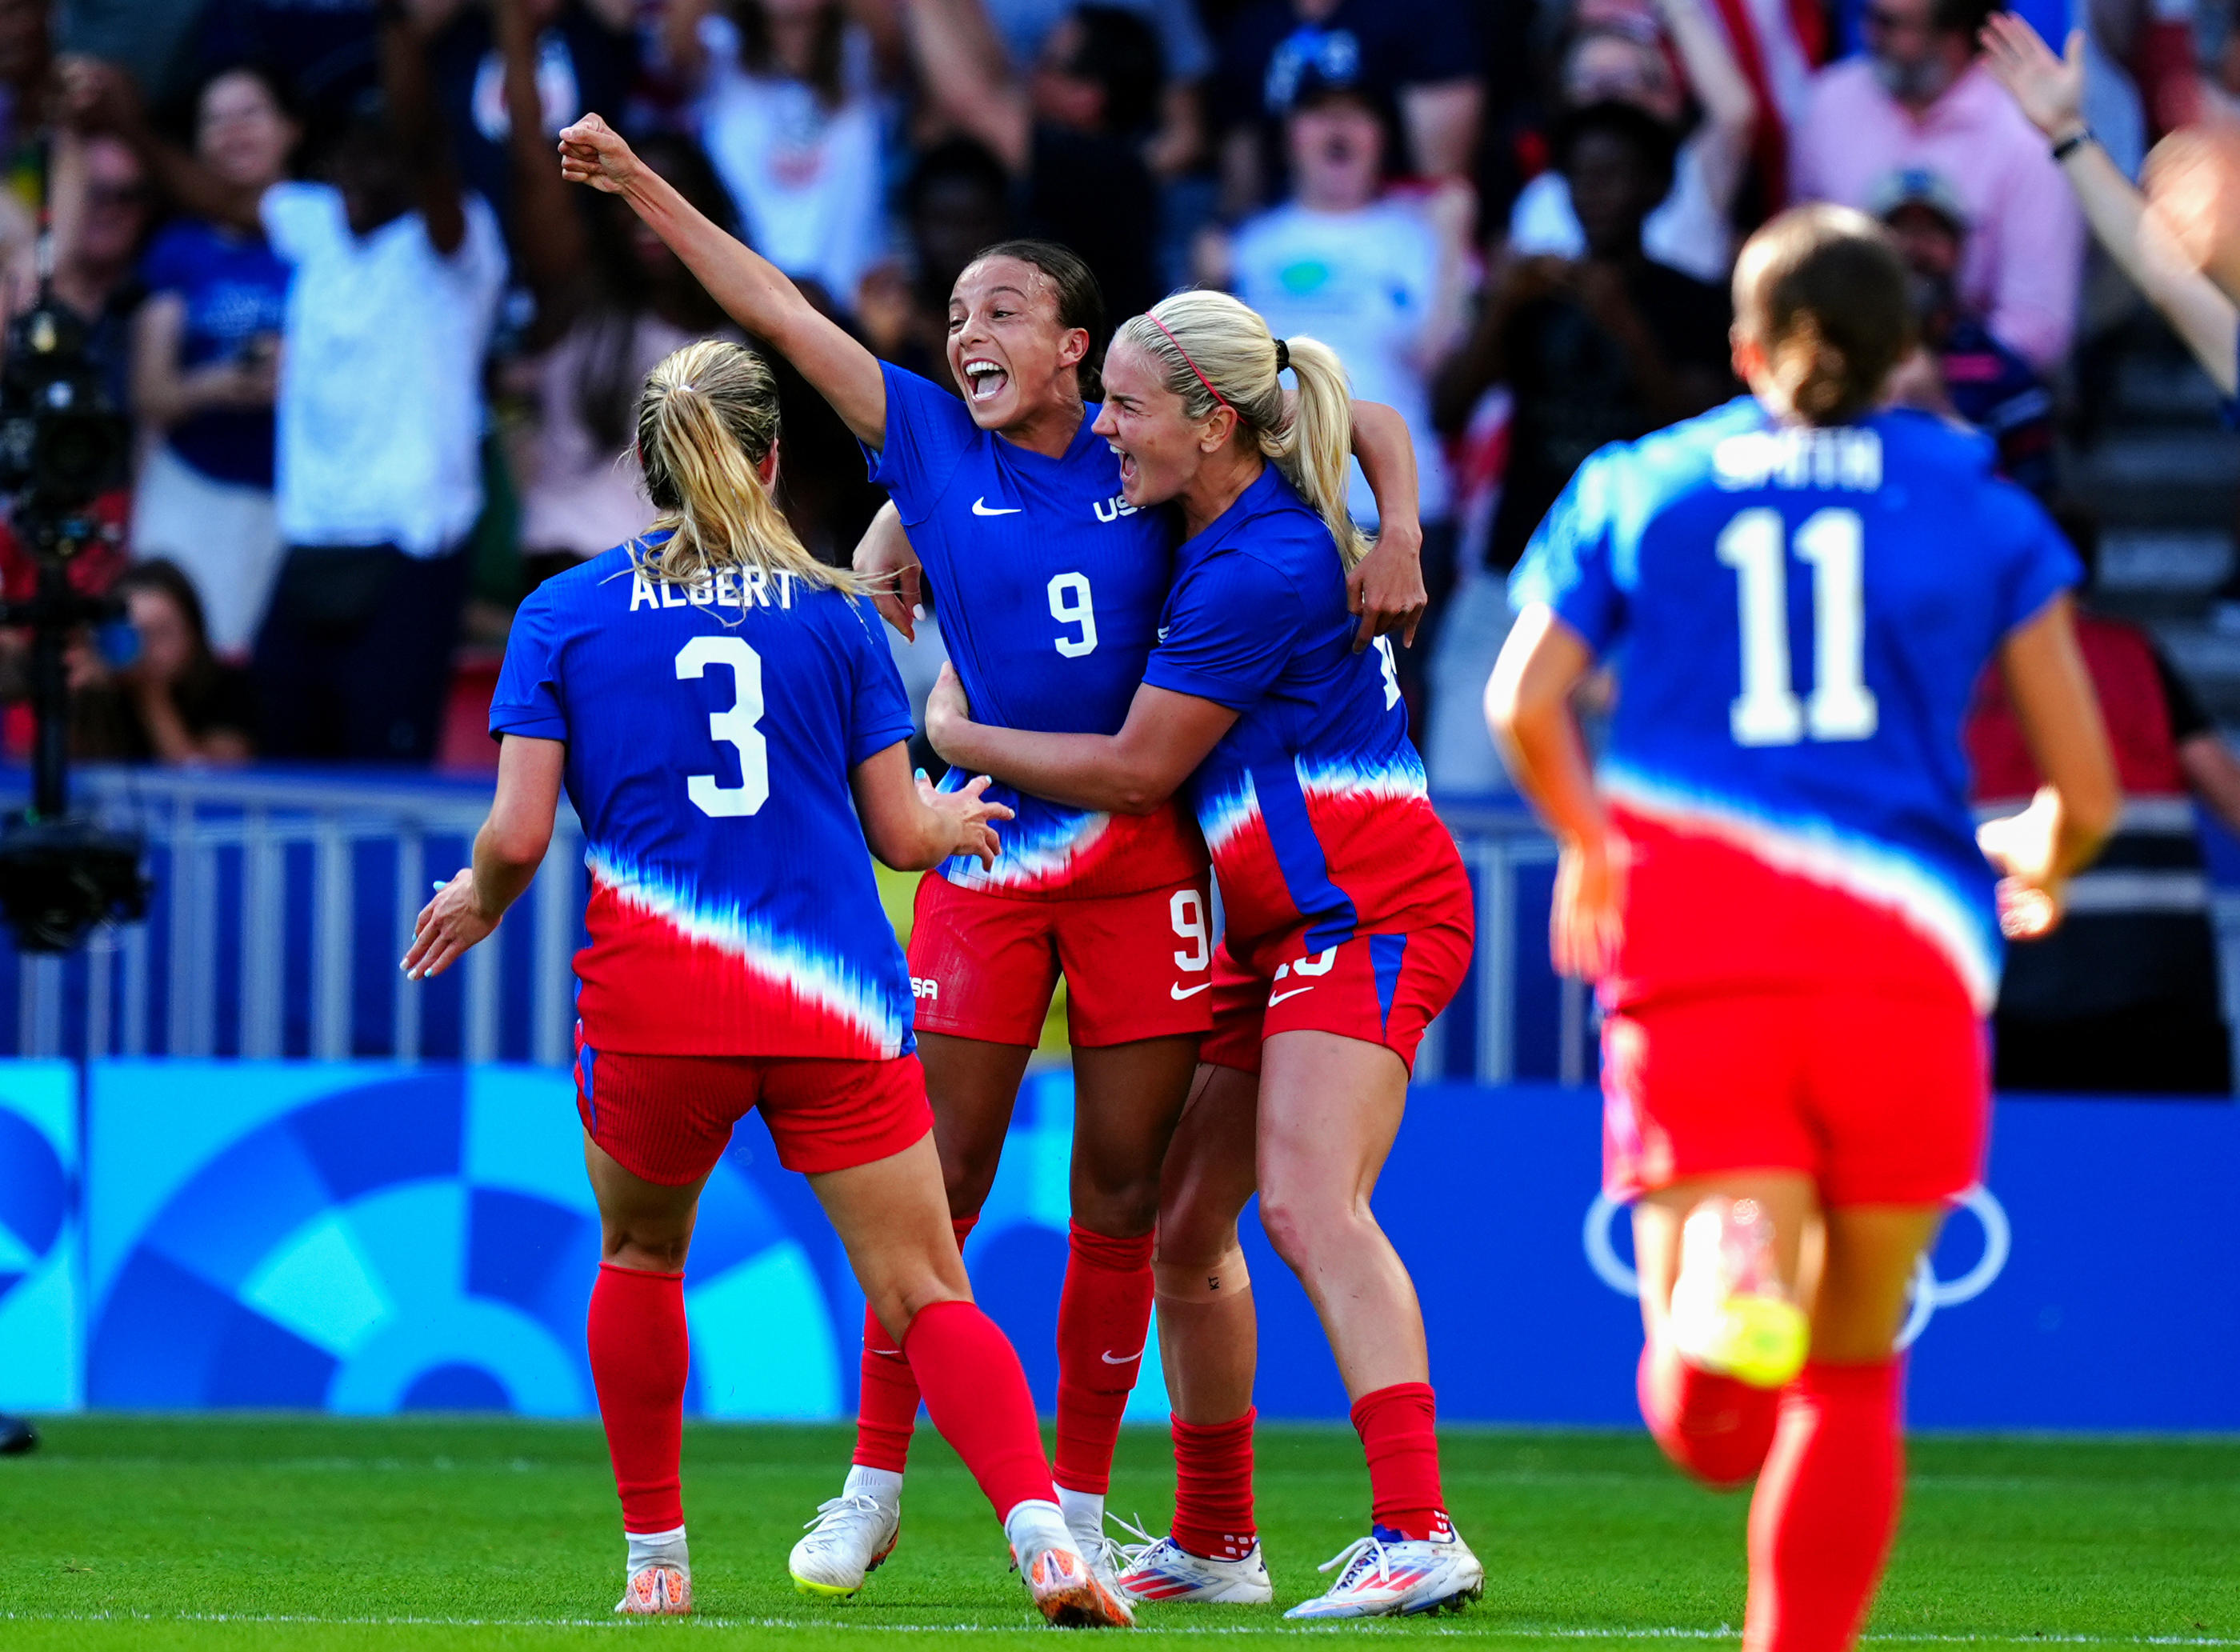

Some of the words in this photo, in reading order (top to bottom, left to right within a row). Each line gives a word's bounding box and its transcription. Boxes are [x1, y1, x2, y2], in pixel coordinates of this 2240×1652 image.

[1093, 494, 1146, 522] US
[630, 566, 798, 611] ALBERT
[1047, 572, 1098, 658] 9
[1716, 506, 1878, 747] 11
[675, 636, 769, 817] 3
[1170, 890, 1209, 971] 9
[909, 977, 938, 1000] SA
[1208, 1276, 1219, 1290] KT
